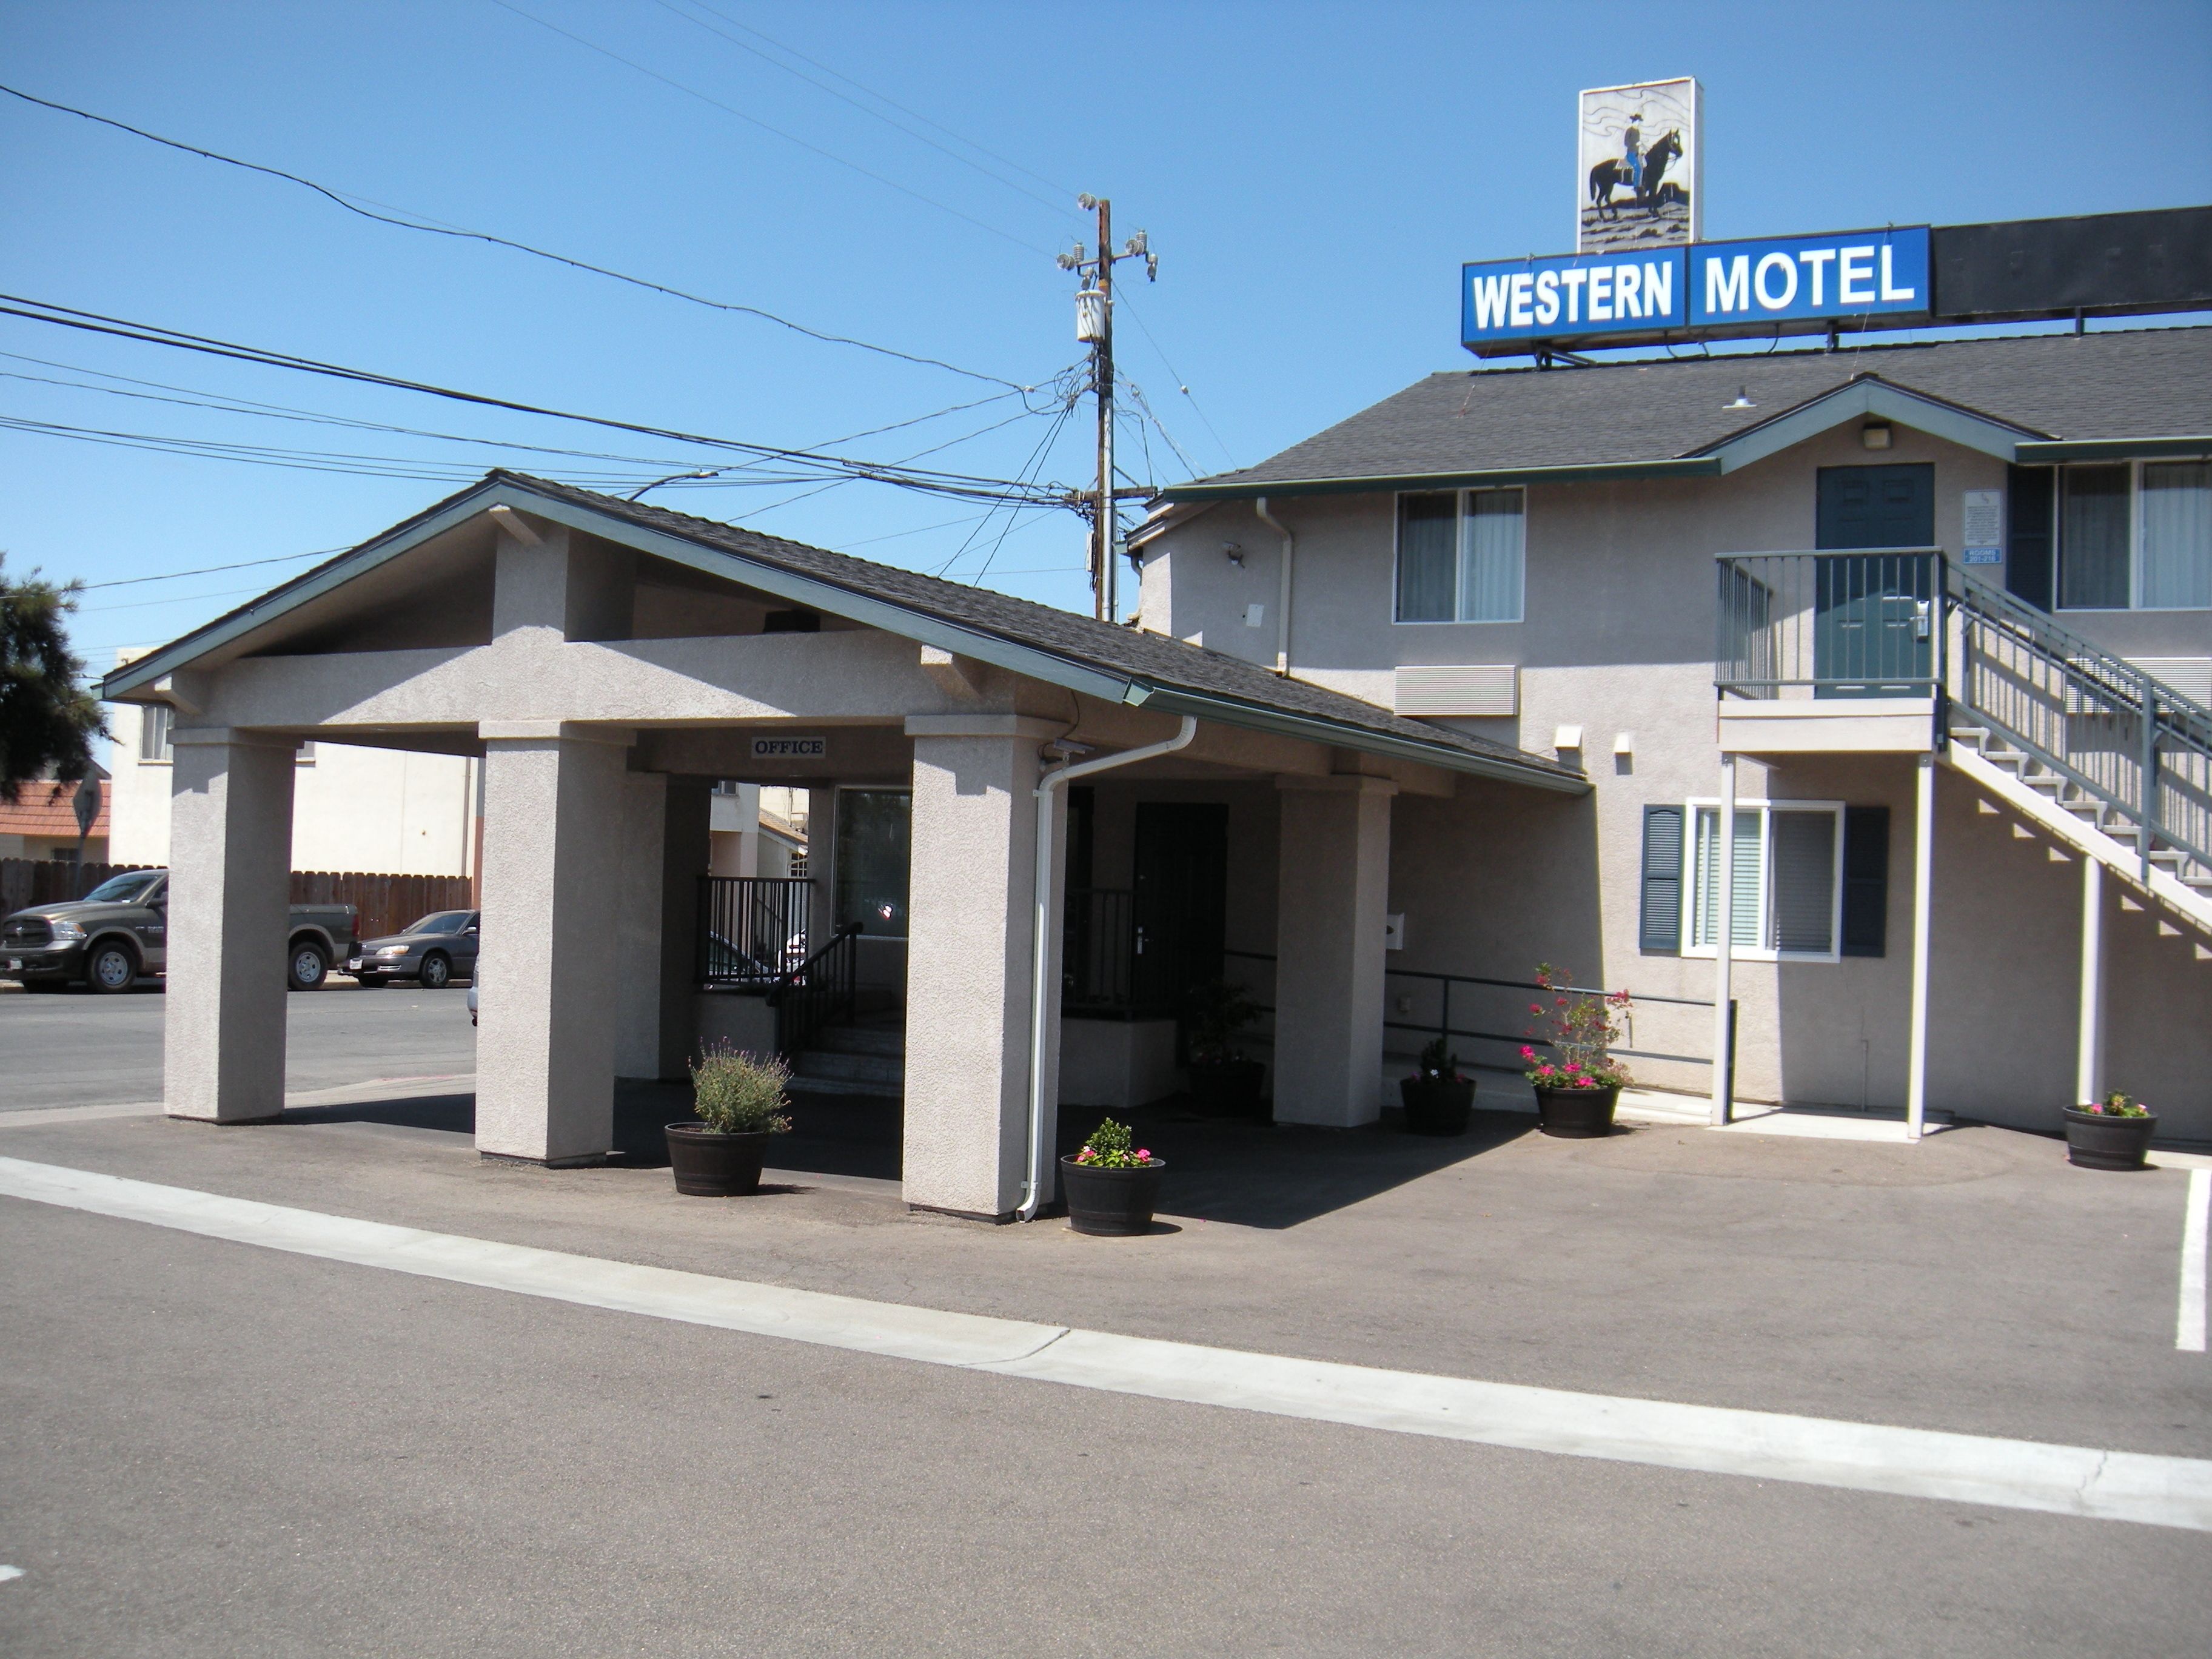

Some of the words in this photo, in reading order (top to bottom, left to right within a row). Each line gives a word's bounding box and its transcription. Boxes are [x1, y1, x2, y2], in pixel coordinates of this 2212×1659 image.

[1474, 261, 1673, 329] WESTERN
[1706, 244, 1915, 313] MOTEL
[755, 740, 823, 754] OFFICE
